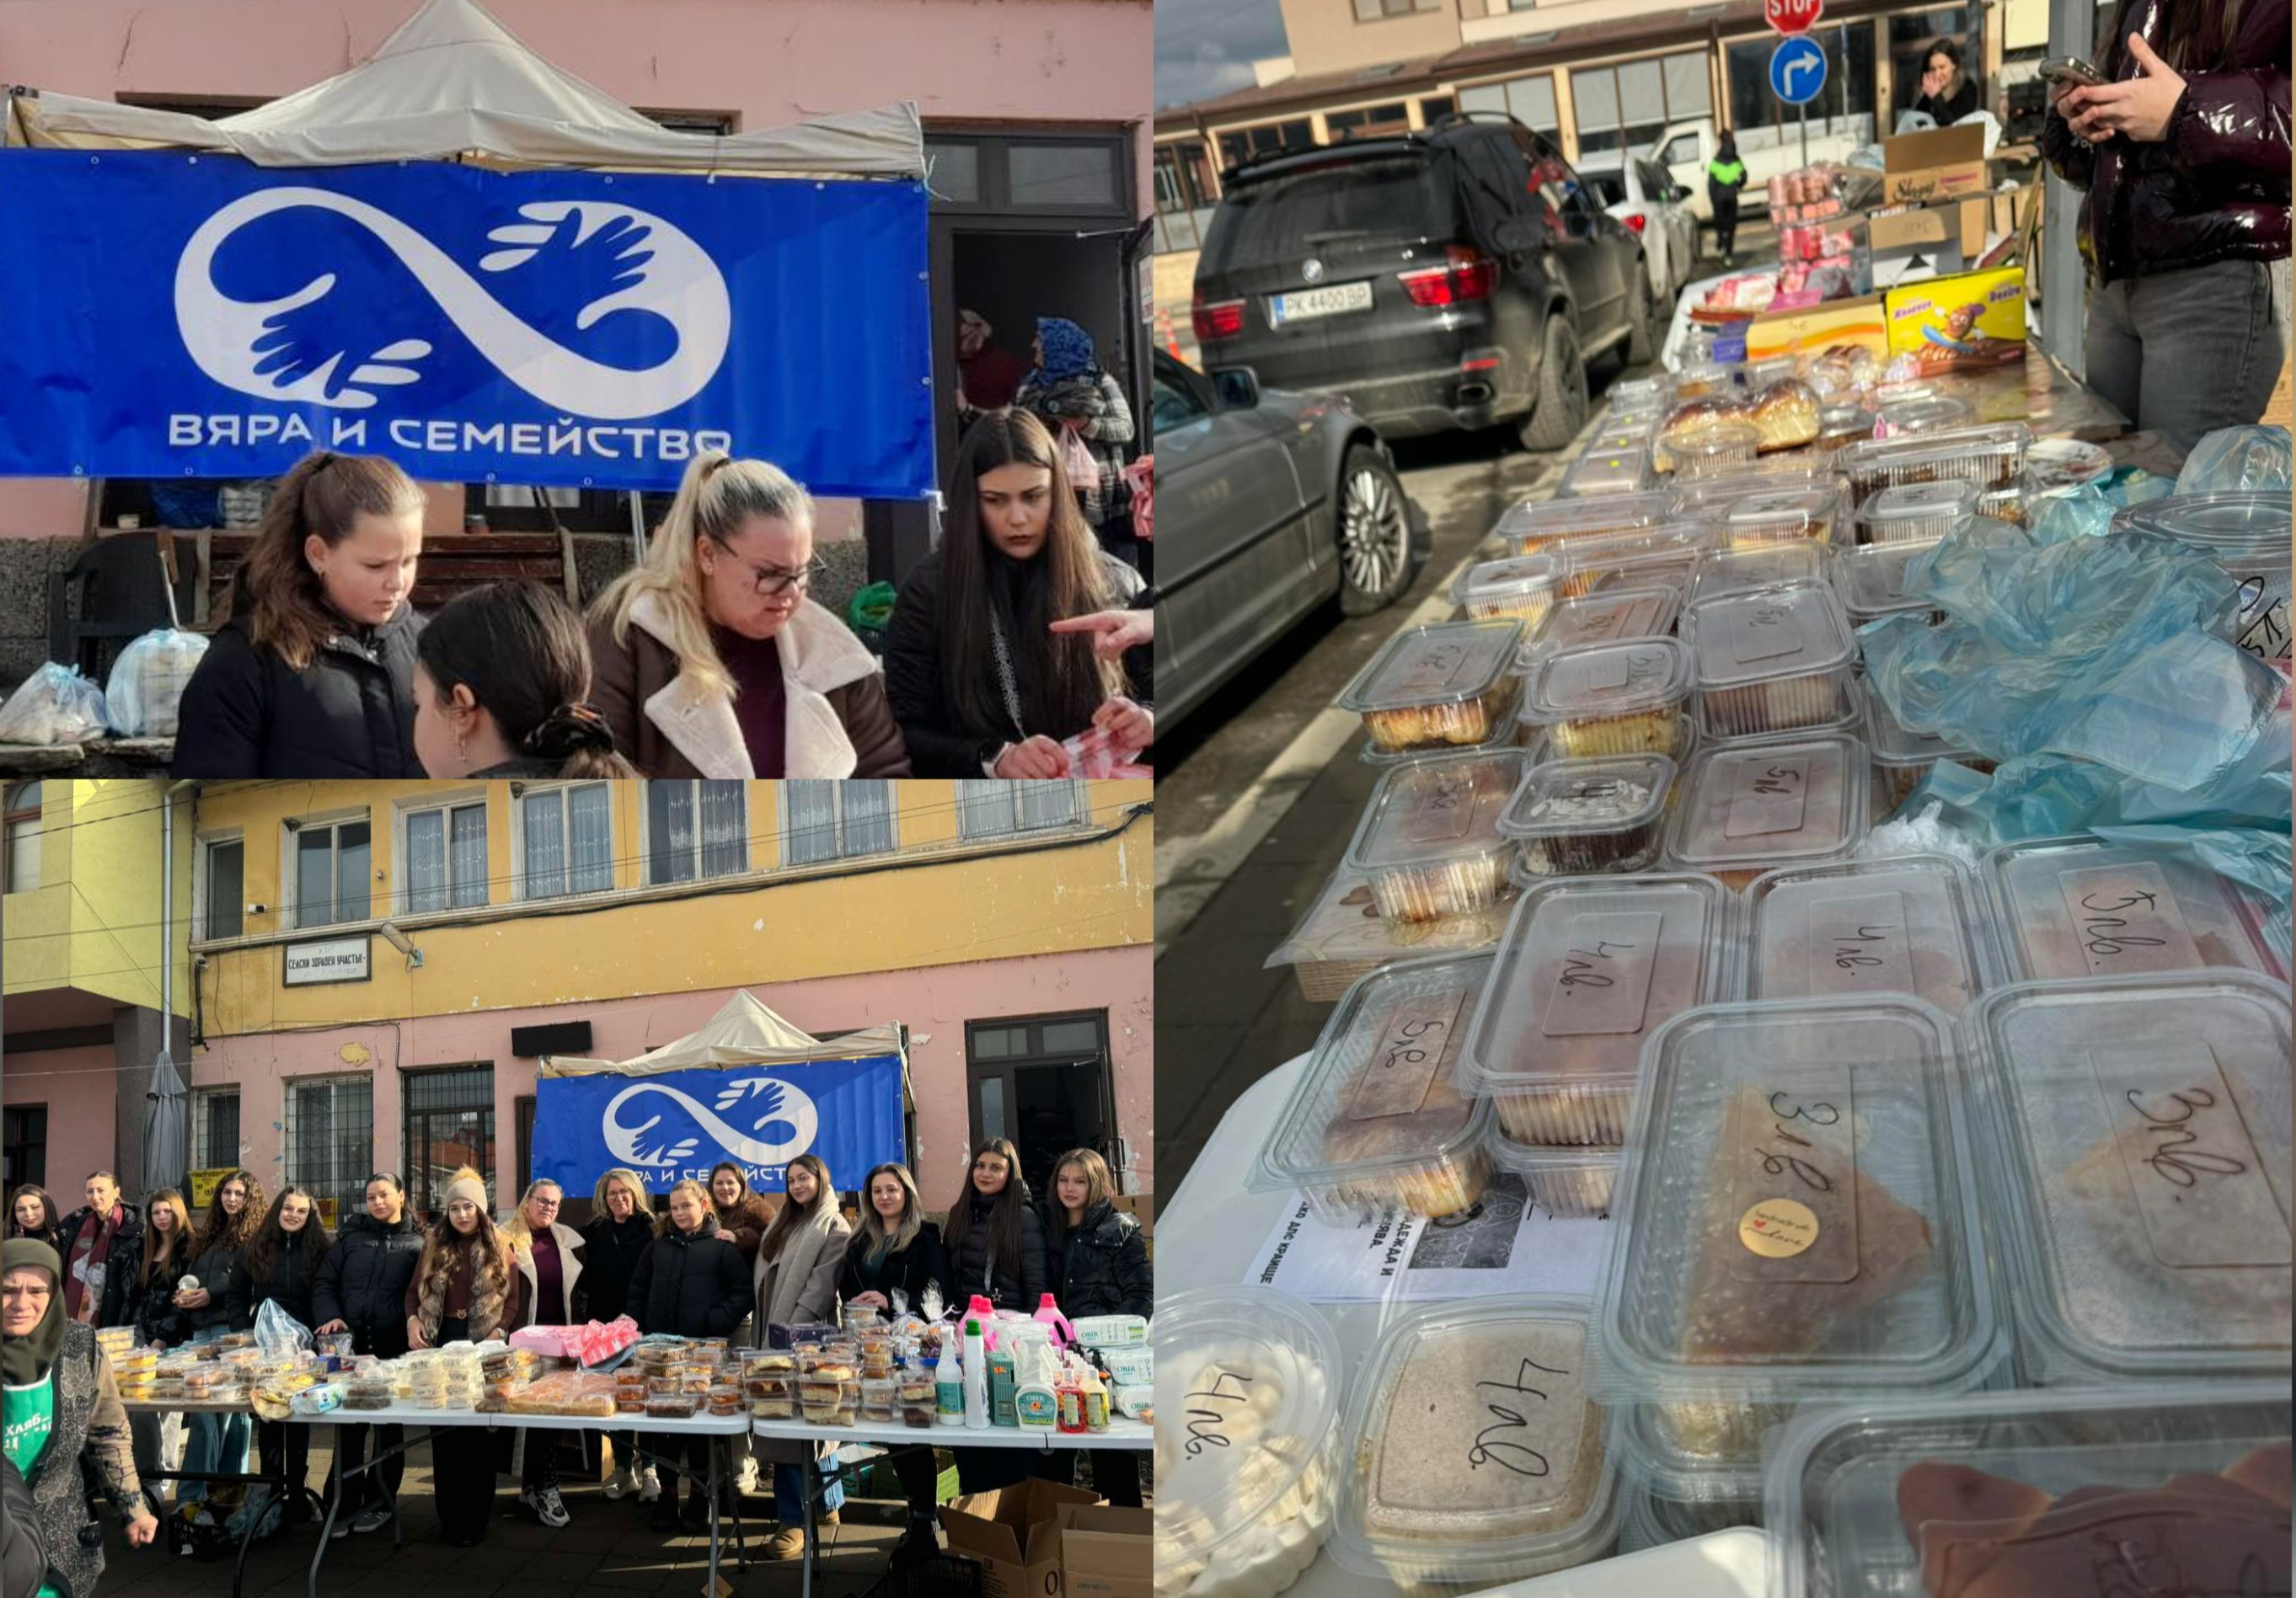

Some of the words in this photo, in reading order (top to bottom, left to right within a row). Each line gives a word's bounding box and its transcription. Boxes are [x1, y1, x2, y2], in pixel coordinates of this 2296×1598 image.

[169, 412, 313, 446] ВЯРА
[333, 418, 366, 446] И
[389, 418, 732, 461] СЕМЕЙСТВО
[288, 958, 310, 970] СЕЛСКИ
[311, 955, 336, 968] ЗДРАВЕН
[661, 1169, 674, 1182] И
[1260, 1242, 1290, 1284] КРАИЩЕ
